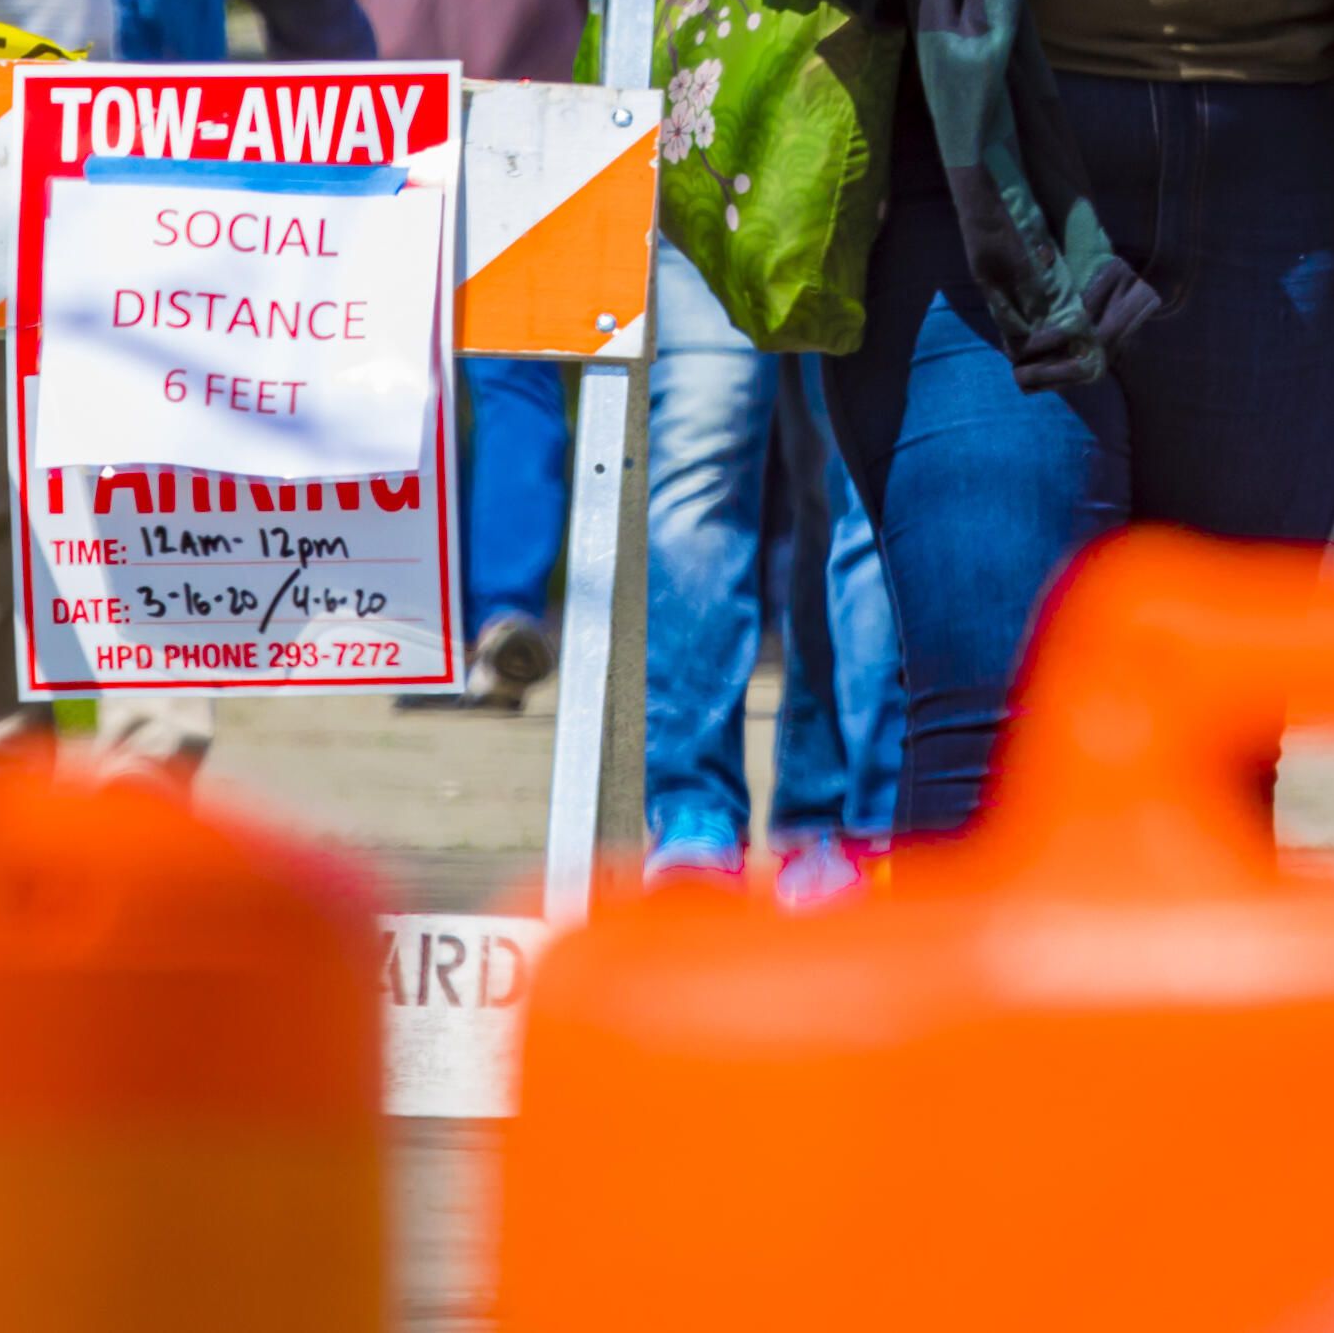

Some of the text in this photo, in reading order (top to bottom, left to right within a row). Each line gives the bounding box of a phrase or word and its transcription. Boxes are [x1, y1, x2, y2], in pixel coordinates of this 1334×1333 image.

[50, 84, 425, 164] TOW-AWAY
[152, 208, 339, 257] SOCIAL
[112, 288, 368, 340] DISTANCE
[164, 367, 307, 415] 6 FEET
[50, 539, 127, 566] TIME:
[53, 597, 131, 624] DATE:
[97, 640, 401, 670] HPD PHONE 293-7272
